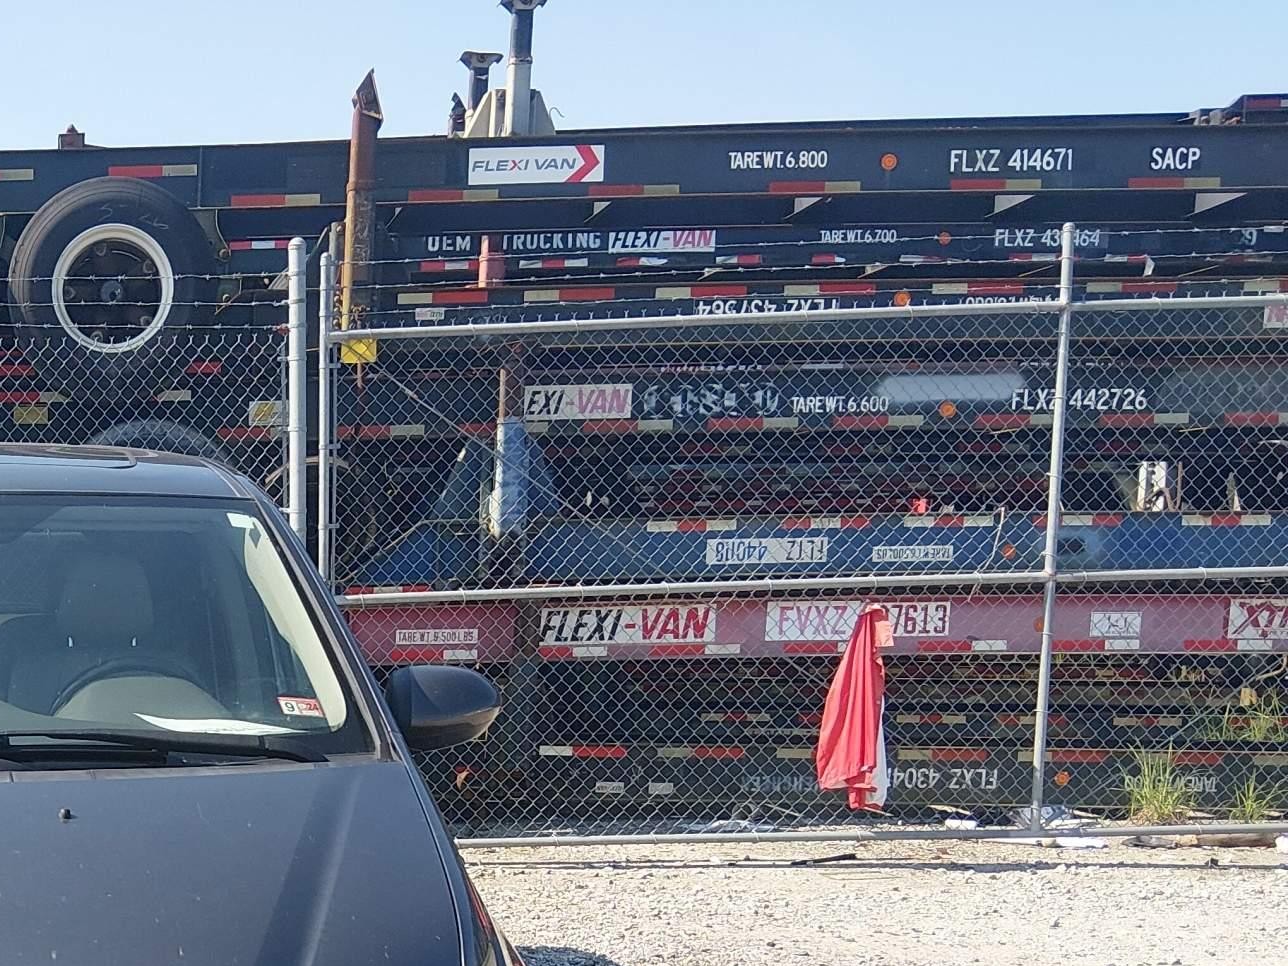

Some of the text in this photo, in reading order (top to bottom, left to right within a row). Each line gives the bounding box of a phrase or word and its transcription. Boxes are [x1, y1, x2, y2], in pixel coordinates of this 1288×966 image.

[472, 158, 577, 172] FLEXI VAN
[949, 148, 1073, 173] FLXZ 414671
[1150, 147, 1201, 170] SACP
[502, 231, 601, 251] TRUCKING
[611, 230, 712, 249] FLEXI-VAN
[994, 228, 1101, 247] FLXZ 43464
[1068, 388, 1148, 410] 442726
[540, 607, 710, 642] FLEXI-VAN
[777, 604, 949, 635] FVXZ 7613
[284, 701, 296, 713] 9
[948, 768, 998, 789] FLXZ
